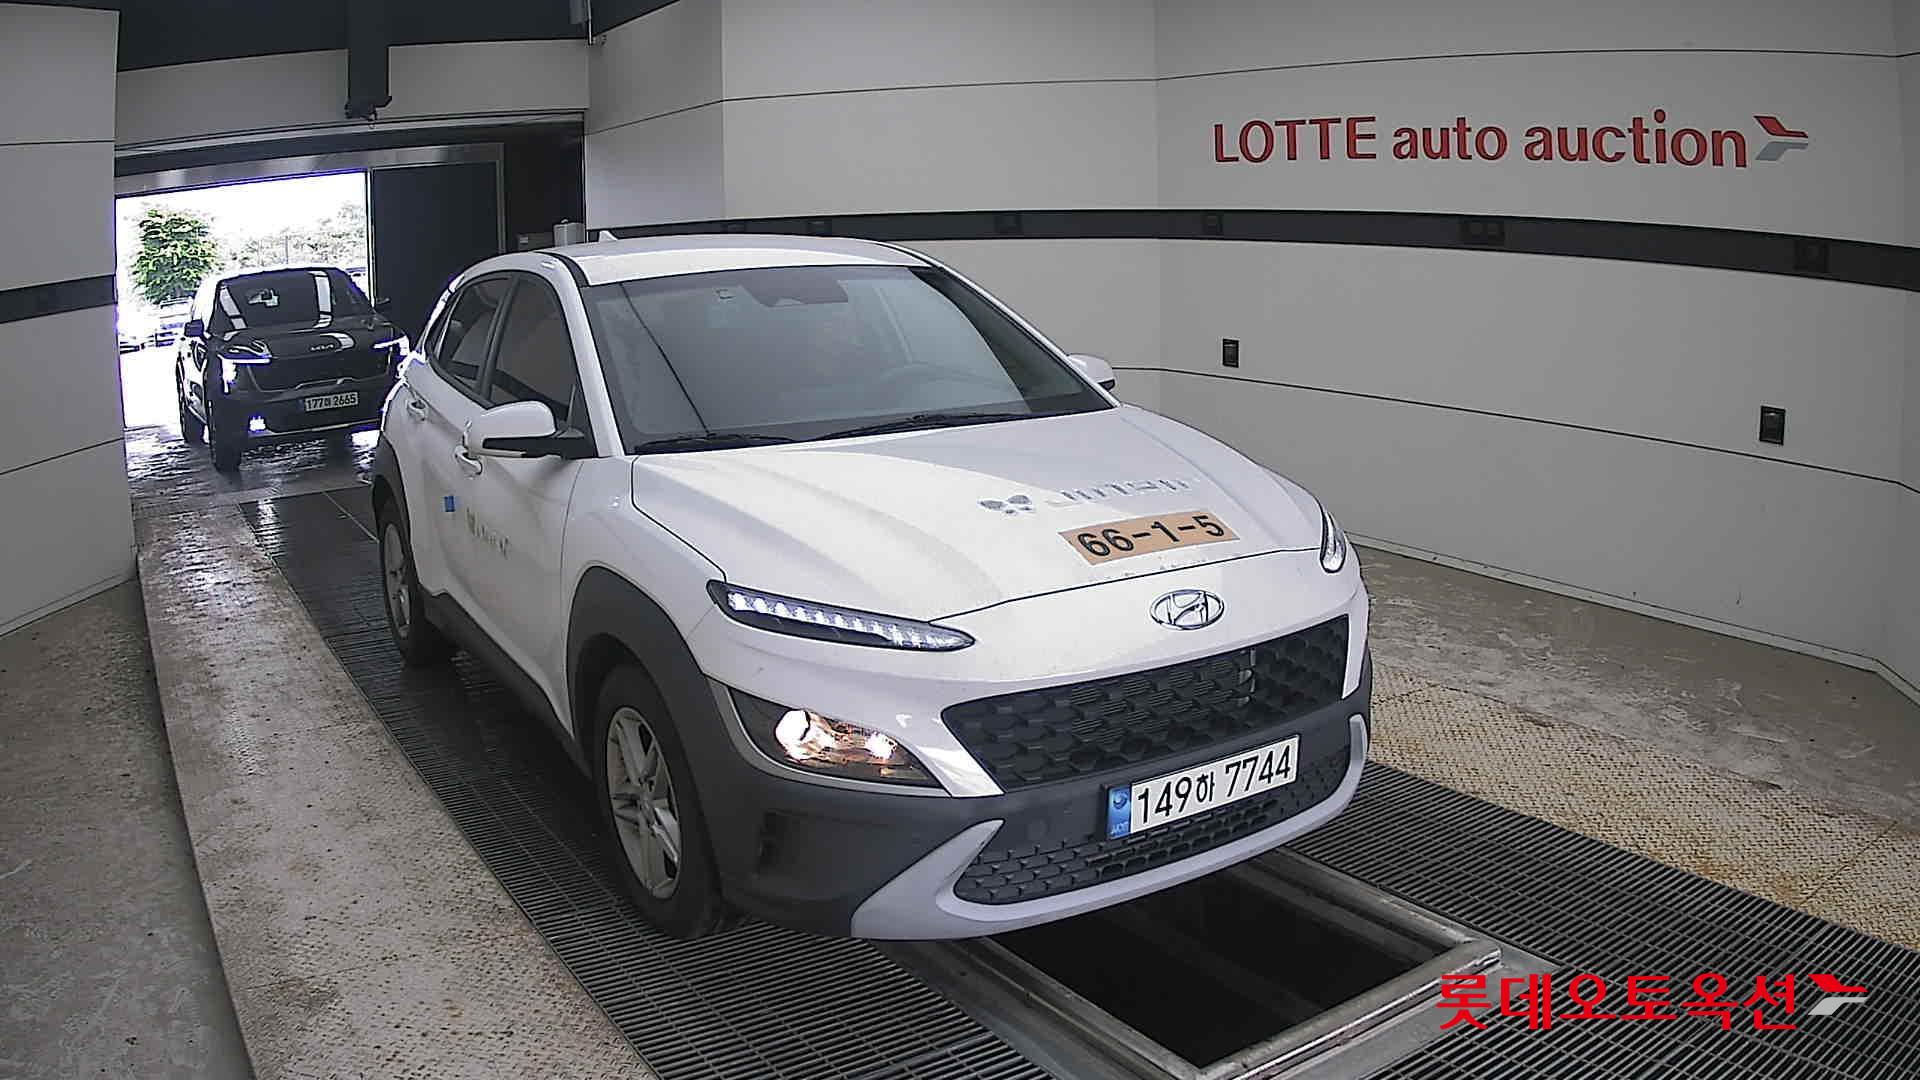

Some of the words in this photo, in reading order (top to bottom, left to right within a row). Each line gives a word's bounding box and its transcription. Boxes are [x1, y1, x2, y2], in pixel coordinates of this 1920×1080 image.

[1213, 116, 1377, 163] LOTTE
[1393, 117, 1508, 162] auto
[1523, 109, 1748, 168] auction
[333, 393, 357, 406] 2665
[1077, 515, 1225, 557] 66-1-5
[1138, 771, 1216, 824] 149하
[1225, 745, 1291, 798] 7744
